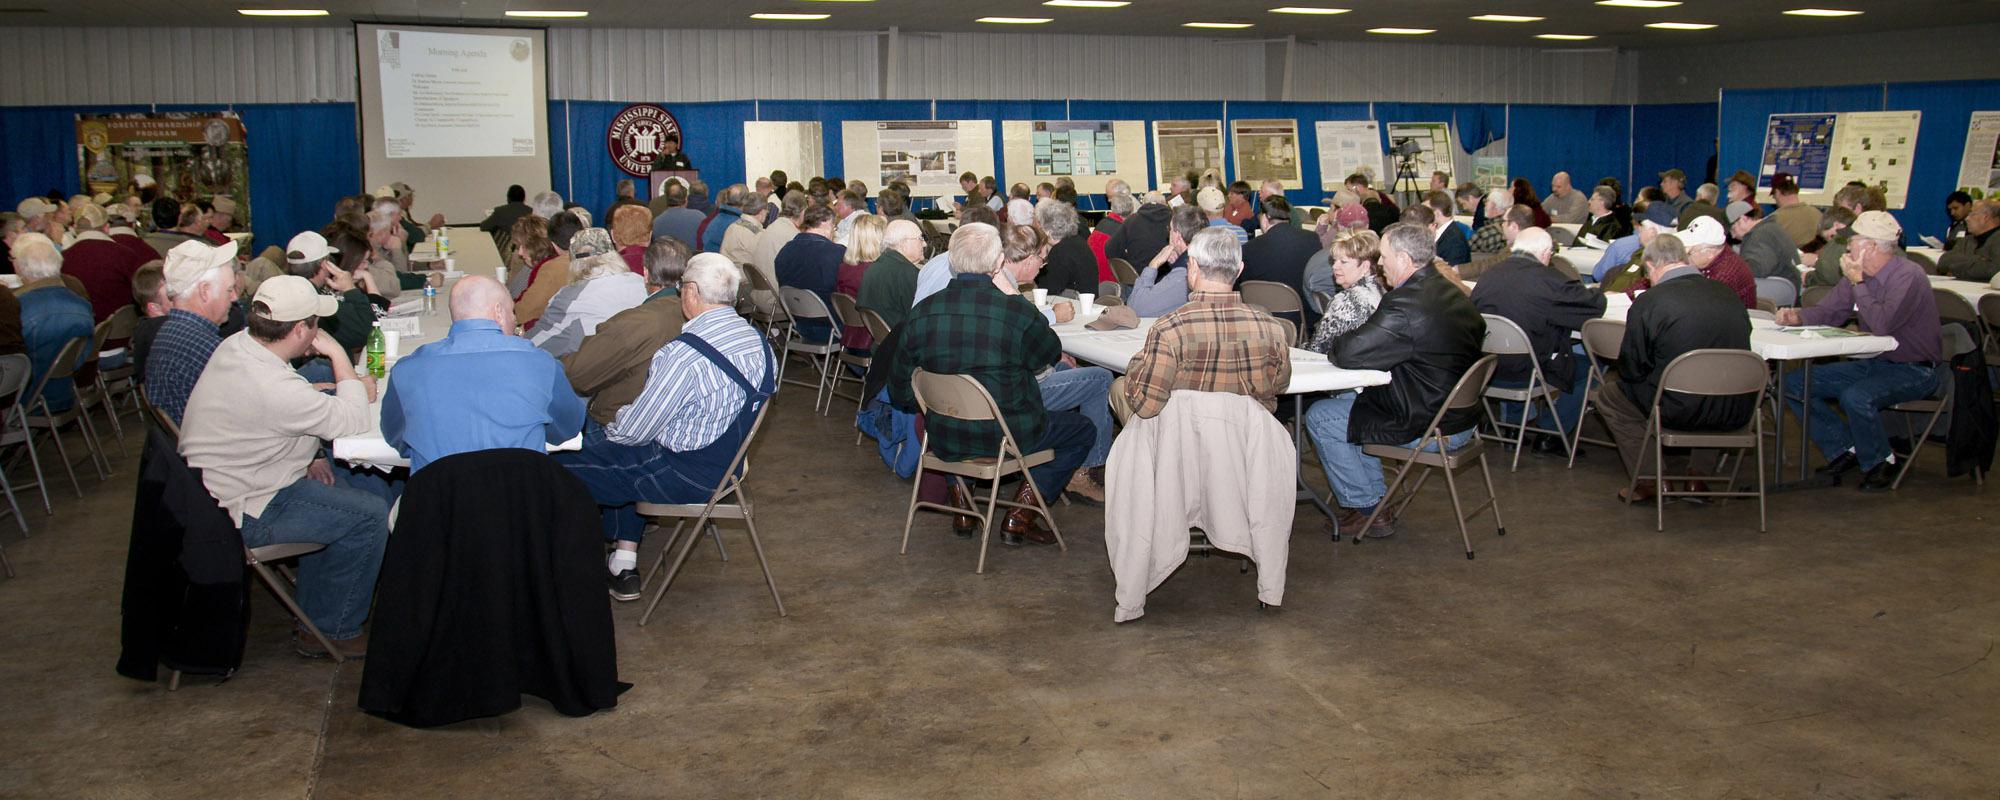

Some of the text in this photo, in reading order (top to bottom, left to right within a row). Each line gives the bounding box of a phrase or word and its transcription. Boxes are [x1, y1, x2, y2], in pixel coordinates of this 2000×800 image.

[428, 47, 487, 58] Morning Agenda
[611, 107, 677, 140] MISSISSIPPI STAT
[619, 154, 652, 174] UNIVER
